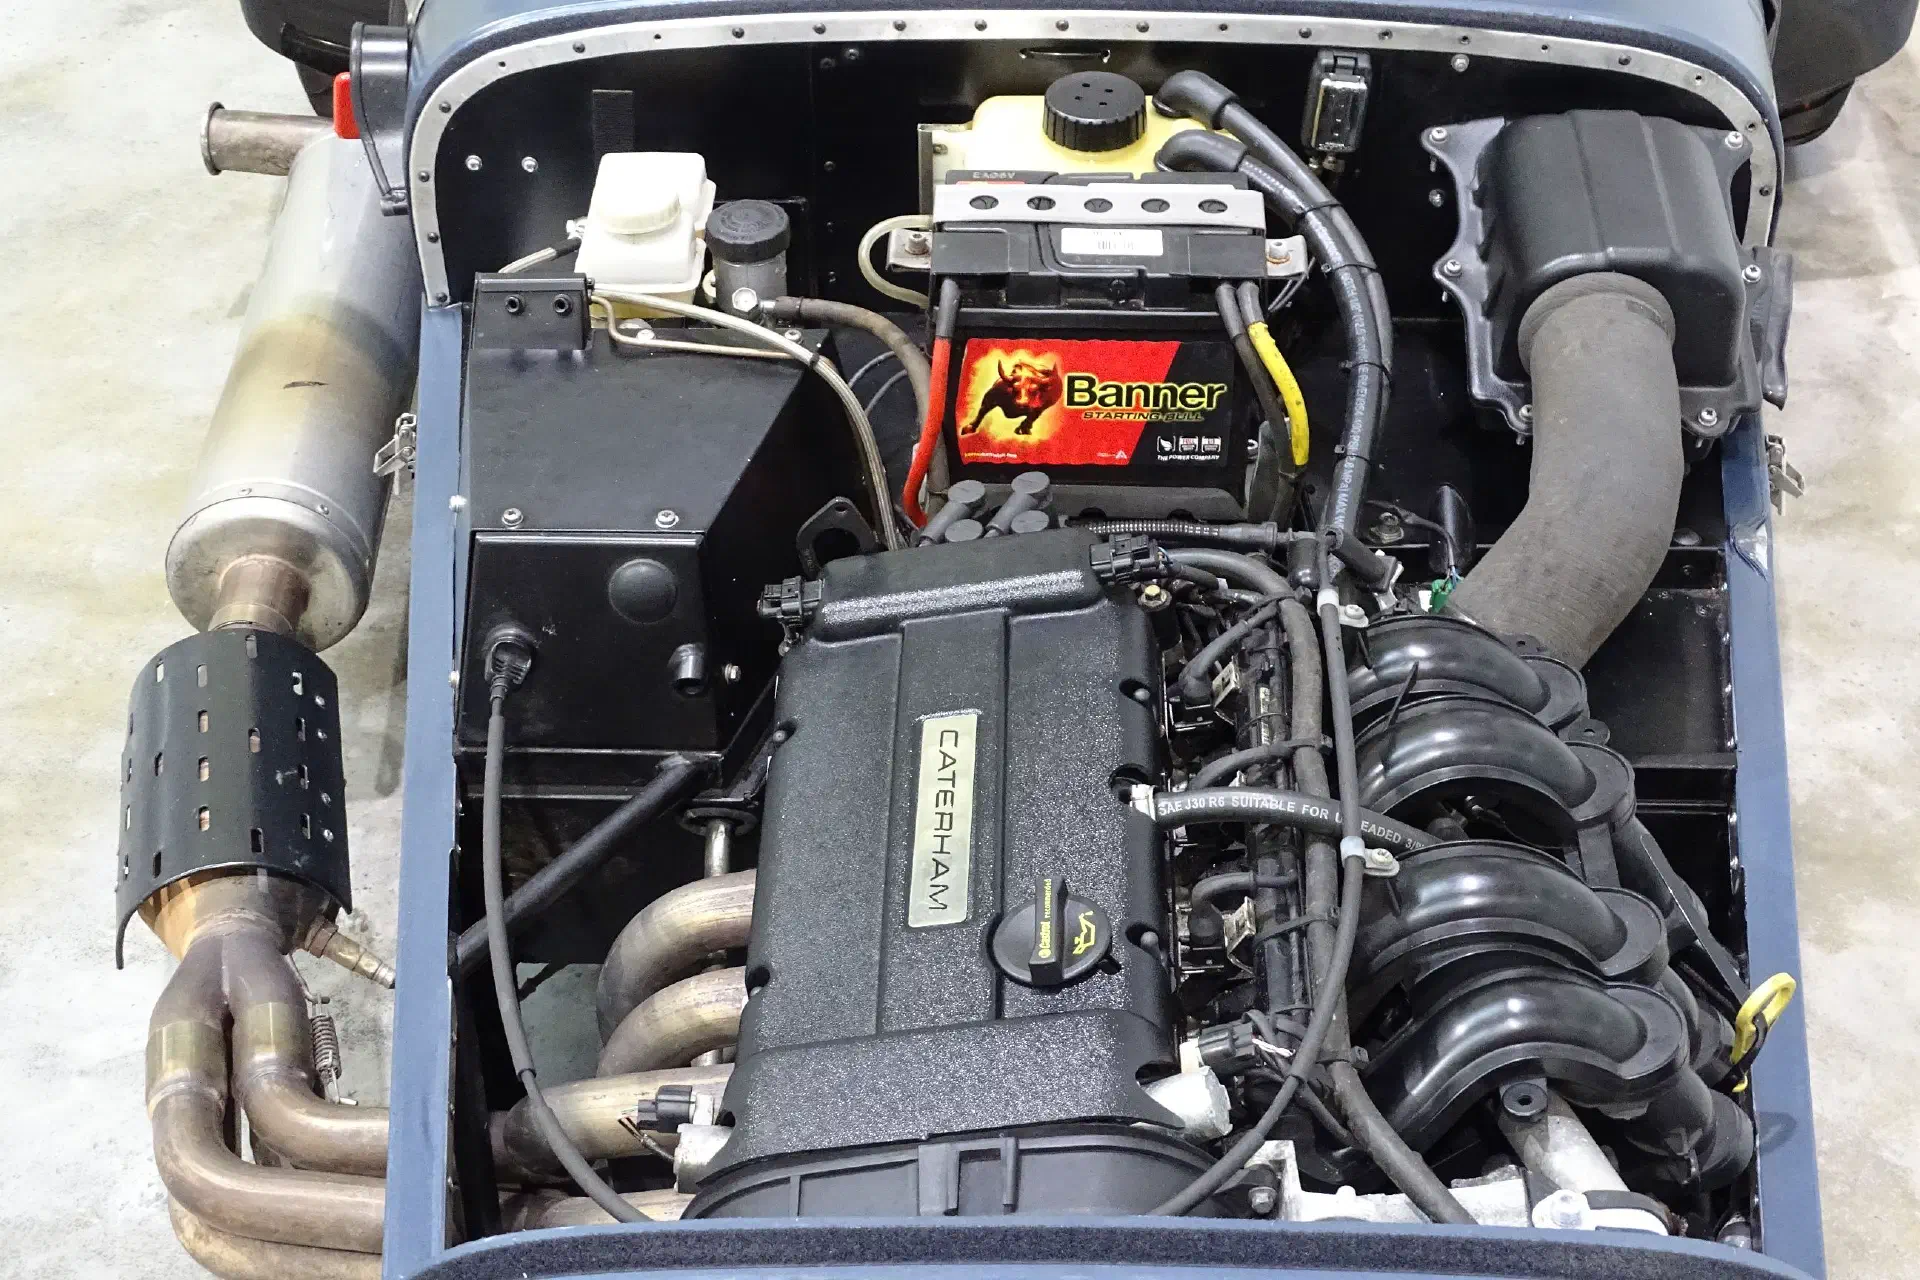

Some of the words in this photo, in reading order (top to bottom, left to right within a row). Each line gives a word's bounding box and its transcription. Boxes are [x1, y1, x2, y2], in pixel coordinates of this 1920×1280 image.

[1065, 373, 1227, 410] Banner
[1083, 411, 1160, 420] STARTING
[1162, 411, 1204, 422] BULL
[928, 729, 959, 911] CATERHAM
[1158, 800, 1183, 816] SAE
[1185, 797, 1206, 810] J30
[1208, 796, 1225, 808] R6
[1231, 795, 1296, 813] SUITABLE
[1301, 804, 1329, 820] FOR
[1044, 878, 1052, 918] recommended
